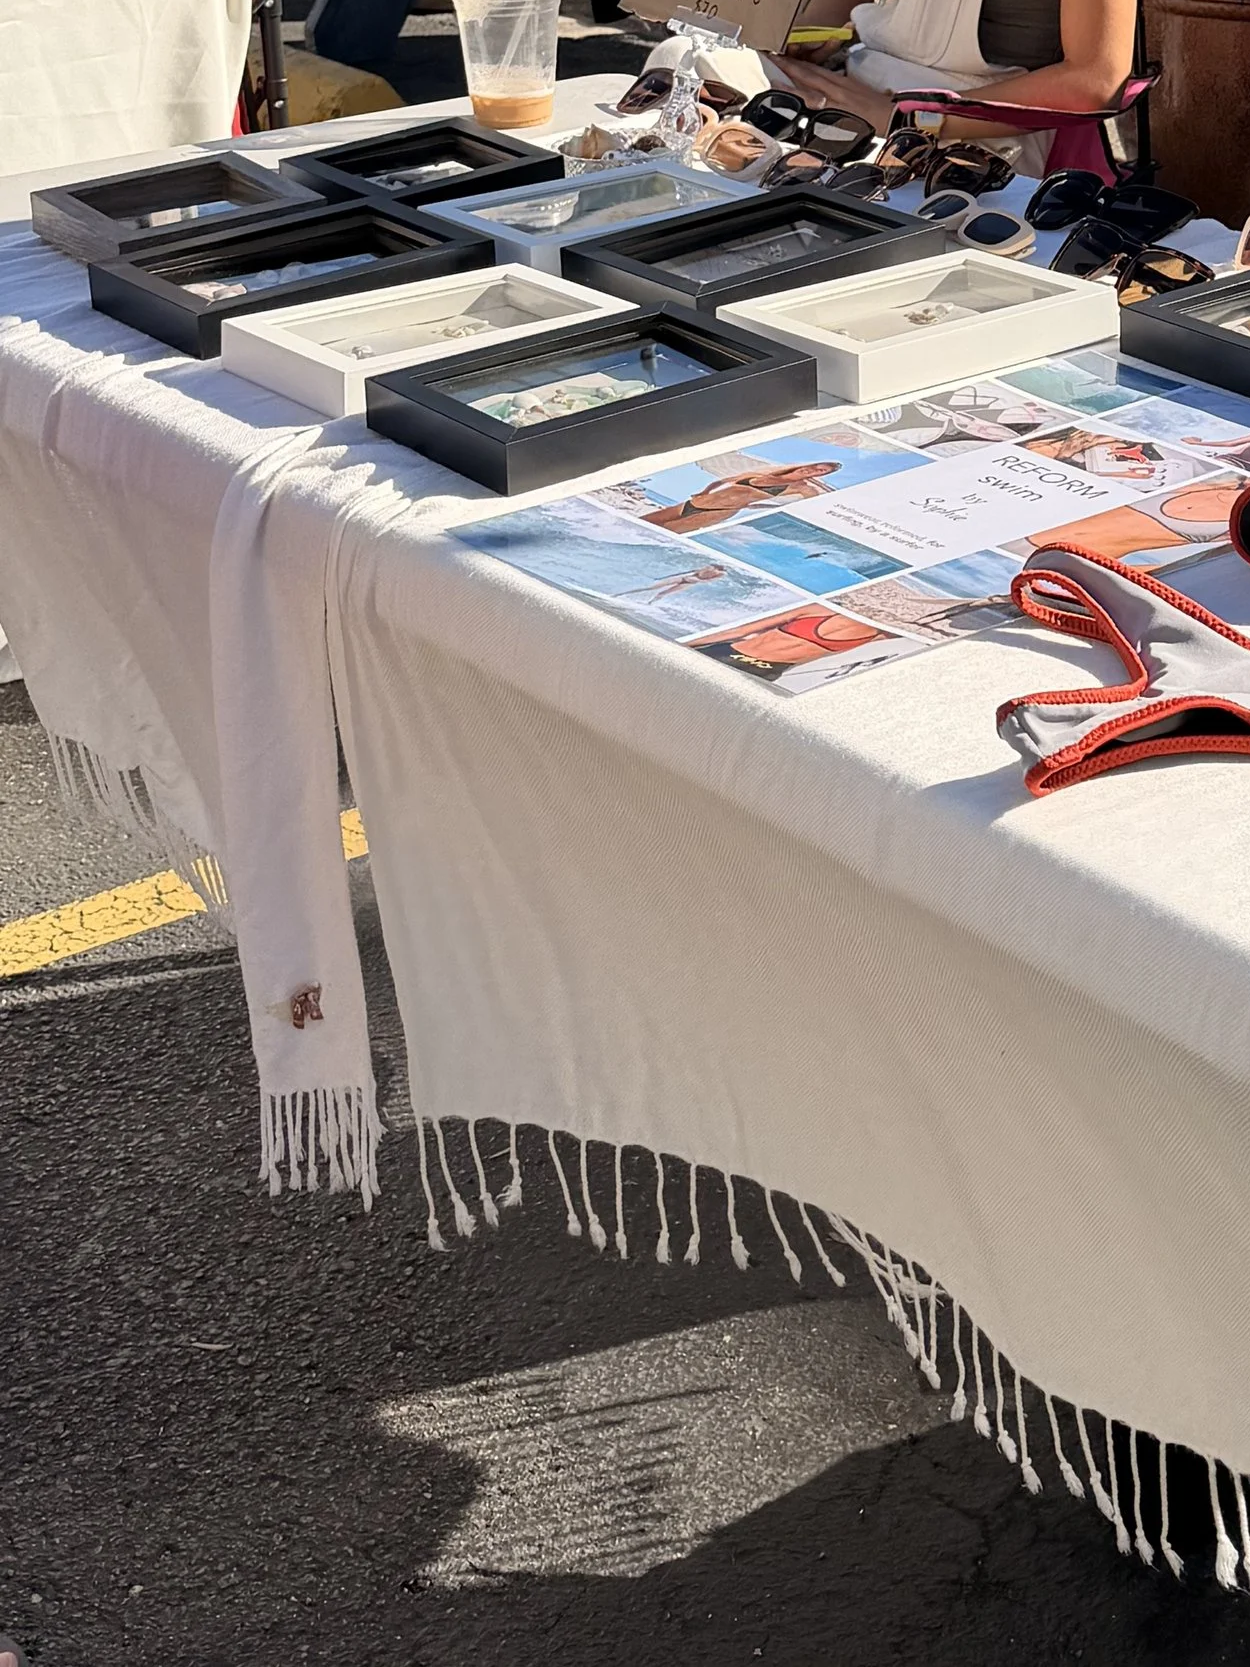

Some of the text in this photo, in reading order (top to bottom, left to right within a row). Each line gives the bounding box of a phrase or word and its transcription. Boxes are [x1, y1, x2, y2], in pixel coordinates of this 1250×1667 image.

[977, 474, 1044, 503] swim
[991, 455, 1109, 500] REFORM
[909, 497, 968, 522] Sophie
[961, 492, 988, 505] by
